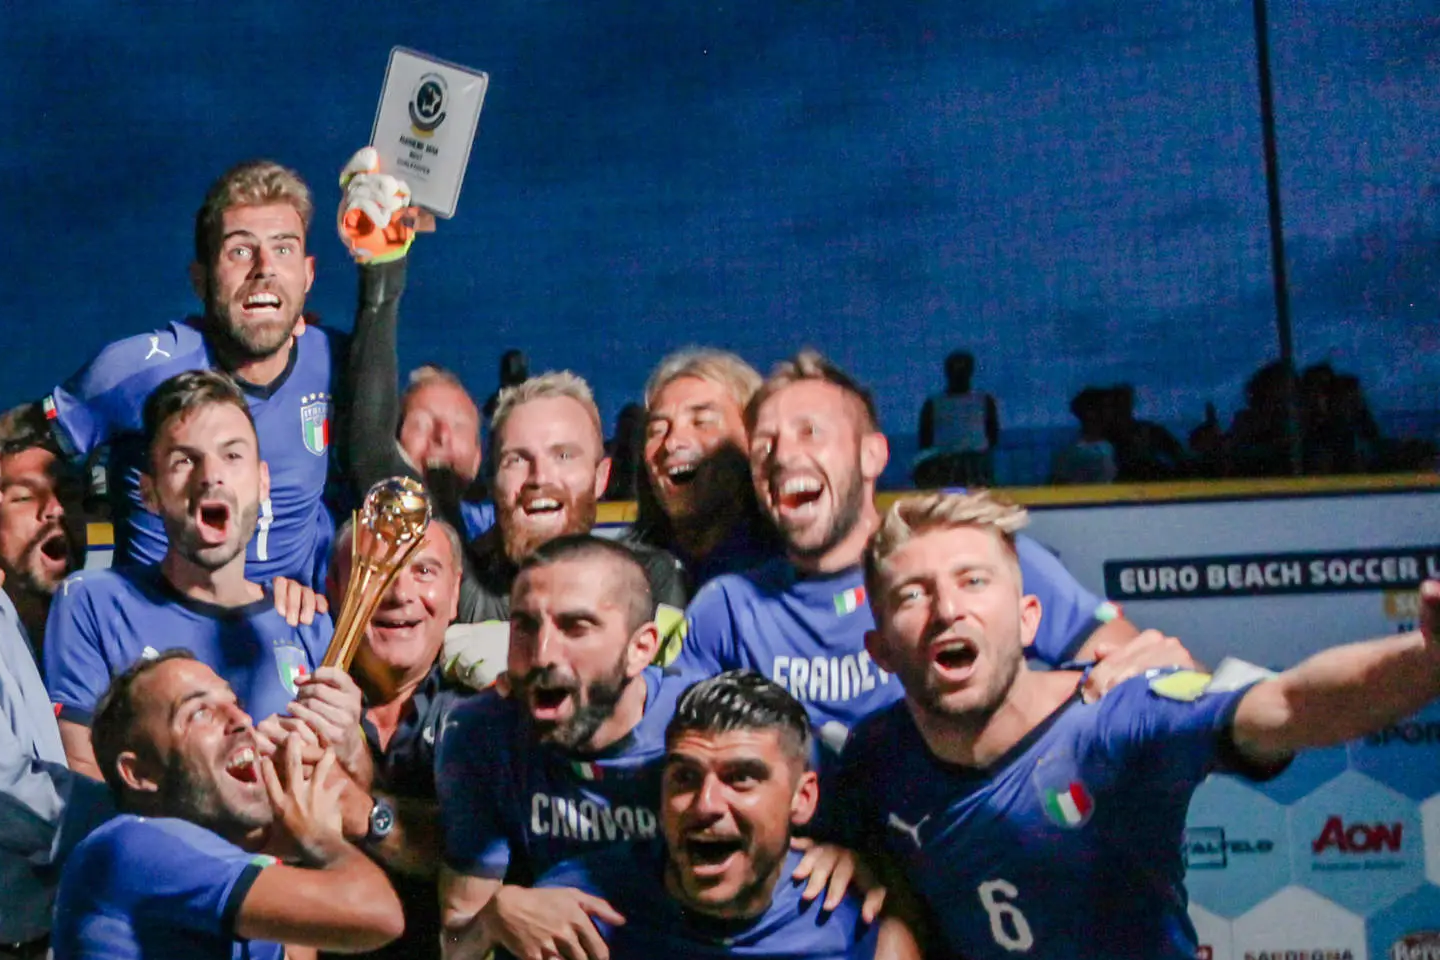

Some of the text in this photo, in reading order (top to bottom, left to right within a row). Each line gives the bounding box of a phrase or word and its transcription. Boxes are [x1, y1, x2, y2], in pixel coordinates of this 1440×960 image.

[1119, 567, 1199, 593] EURO
[1207, 561, 1302, 589] BEACH
[1309, 556, 1419, 585] SOCCER
[977, 878, 1034, 952] 6
